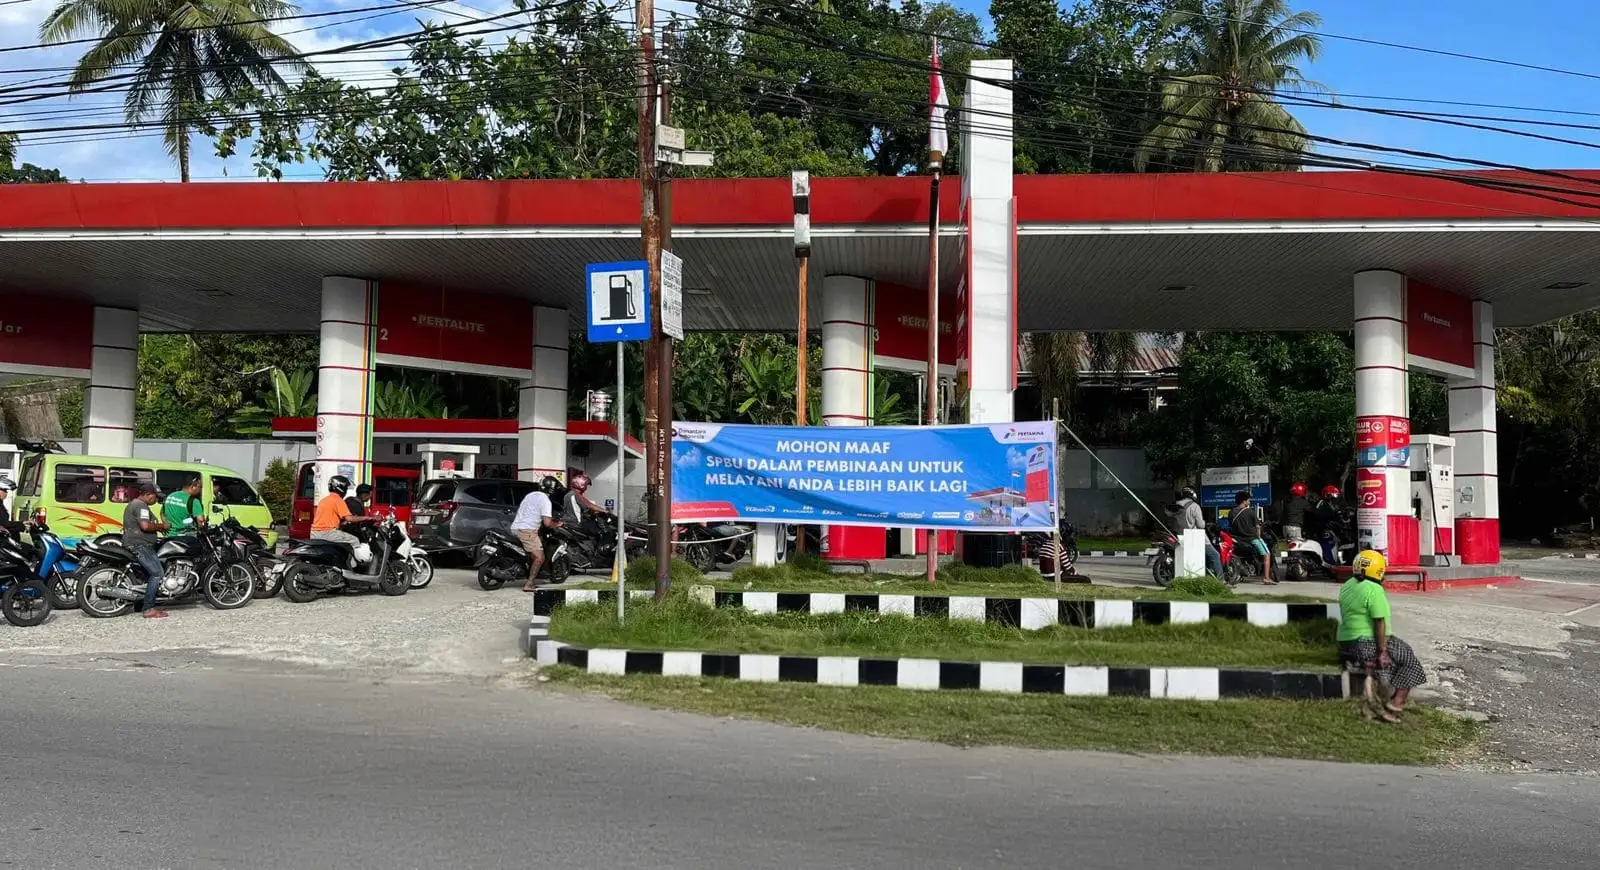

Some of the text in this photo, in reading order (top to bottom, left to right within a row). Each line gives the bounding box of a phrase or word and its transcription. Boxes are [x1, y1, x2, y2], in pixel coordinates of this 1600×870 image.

[418, 314, 485, 332] PERTALITE
[380, 328, 388, 341] 2
[874, 328, 880, 342] 3
[776, 440, 891, 454] MOHON MAAF
[706, 455, 964, 473] SPBU DALAM PEMBINAAN UNTUK
[705, 473, 968, 493] MELAYANI ANDA LEBIH BAIK LAGI
